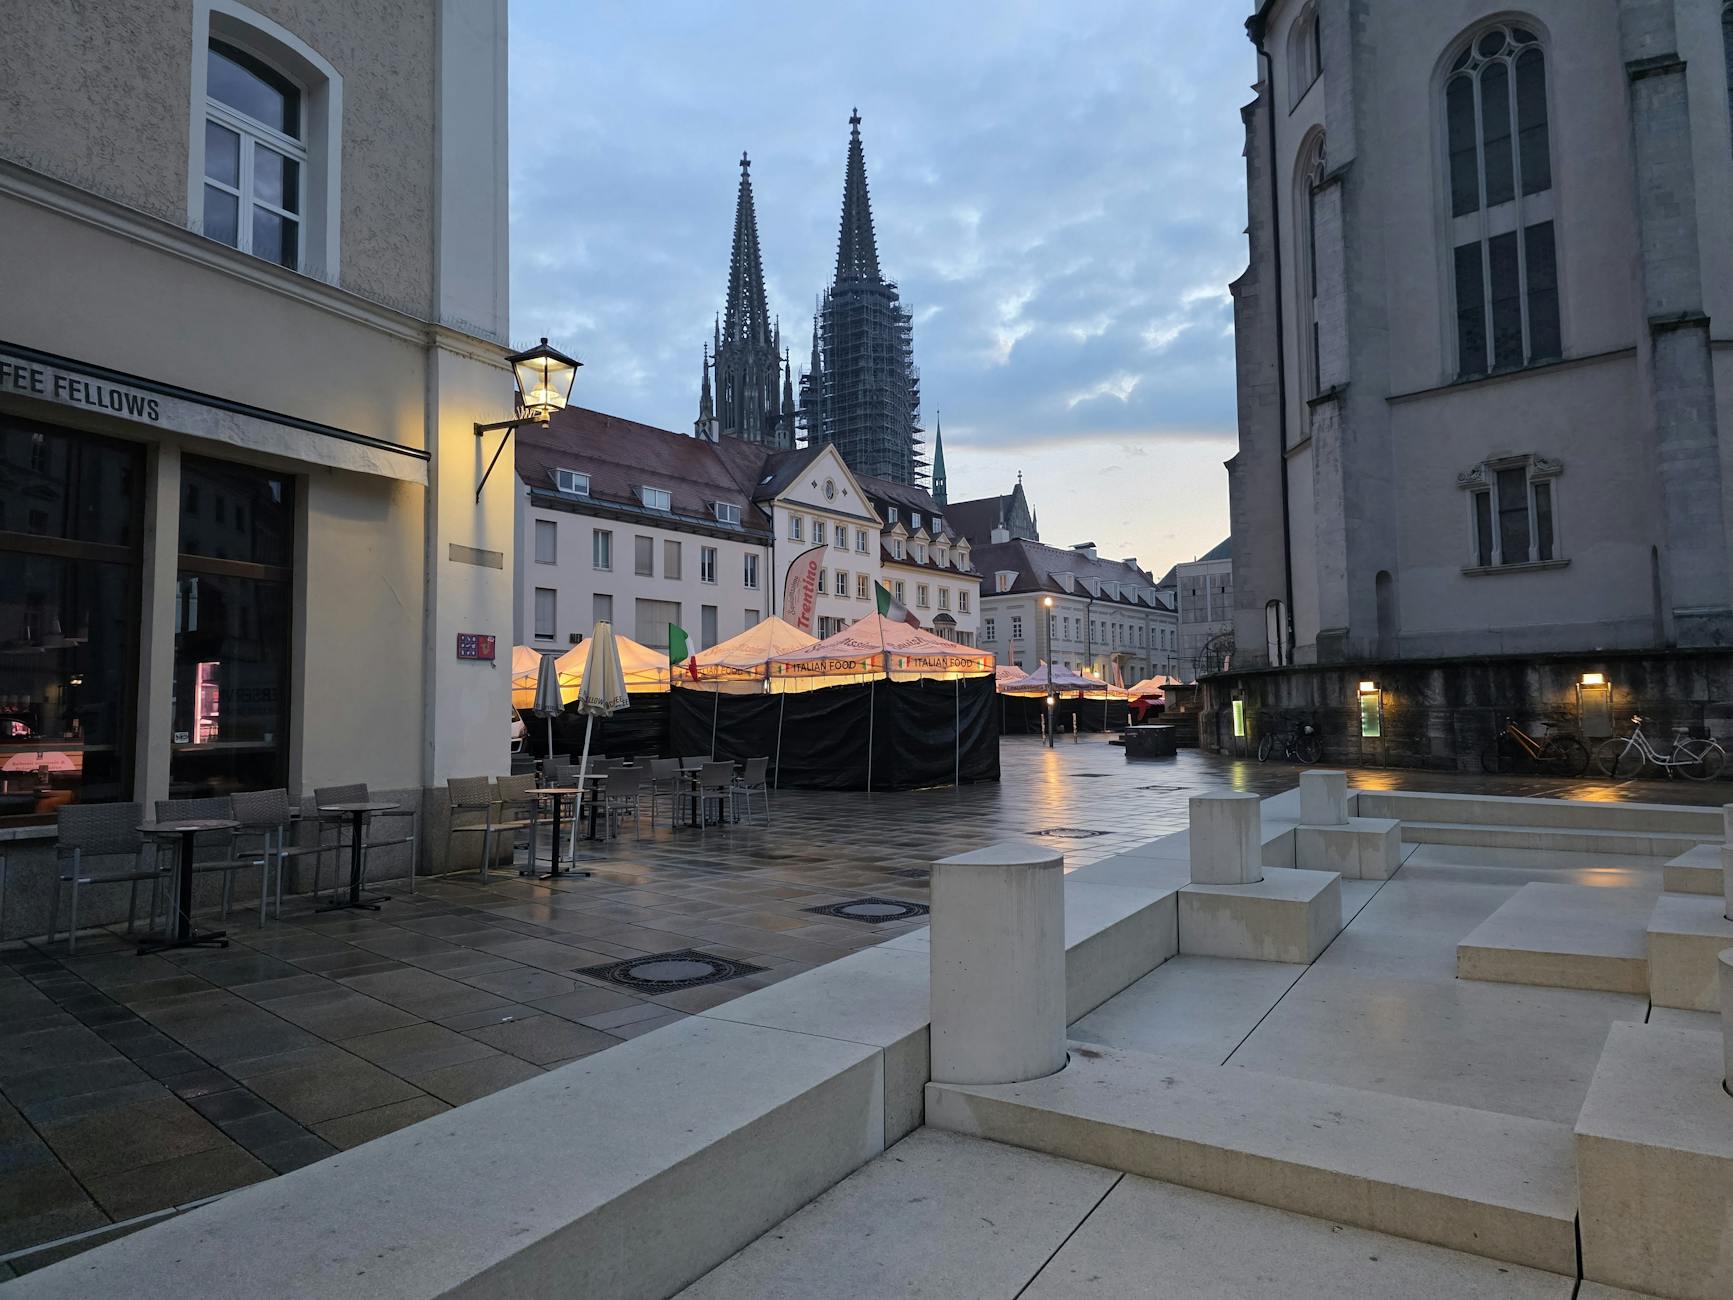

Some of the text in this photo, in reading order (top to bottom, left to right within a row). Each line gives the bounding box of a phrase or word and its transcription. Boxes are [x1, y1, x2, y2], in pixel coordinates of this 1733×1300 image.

[53, 374, 160, 421] FELLOWS
[797, 560, 818, 628] Trentino
[793, 660, 857, 673] ITALIAN FOOD
[914, 657, 973, 669] ITALIAN FOOD
